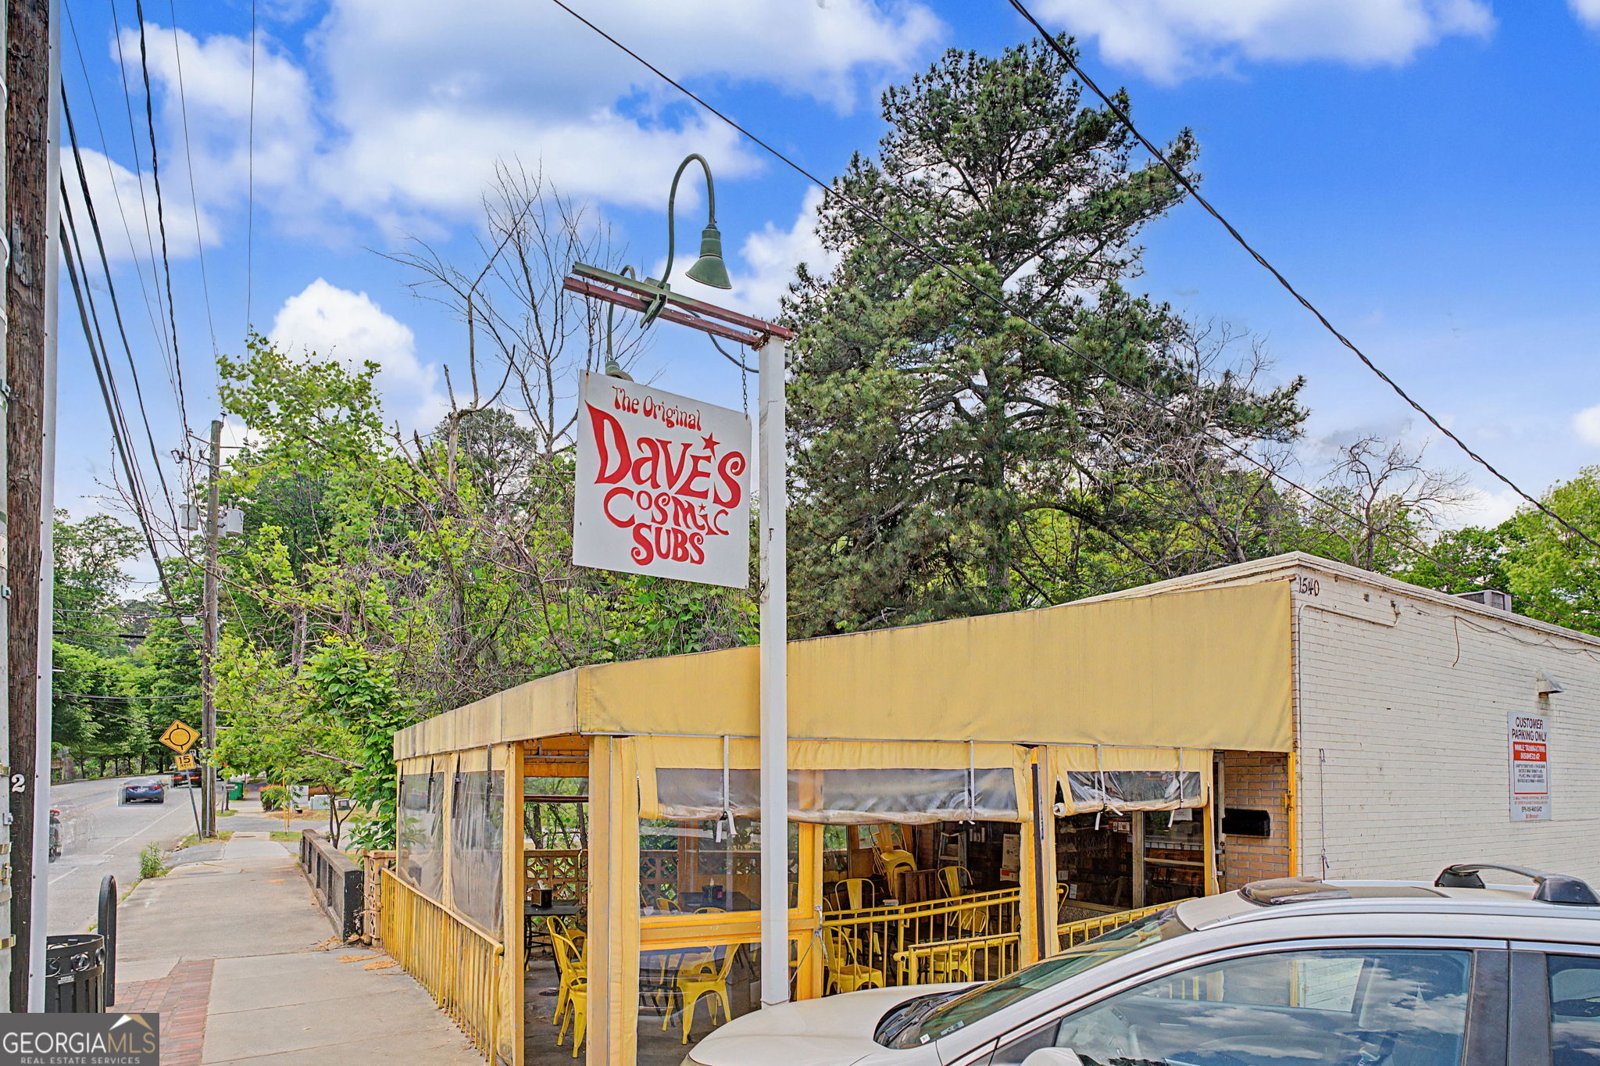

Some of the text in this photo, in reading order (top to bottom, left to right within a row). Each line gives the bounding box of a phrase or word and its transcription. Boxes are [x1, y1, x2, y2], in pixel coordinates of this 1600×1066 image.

[612, 386, 702, 431] The Original
[631, 522, 705, 566] SUBS
[1298, 575, 1320, 597] 1540
[1515, 716, 1544, 730] CUSTOMER
[1511, 728, 1535, 742] PARKING
[179, 756, 191, 765] 15
[11, 773, 26, 793] 2
